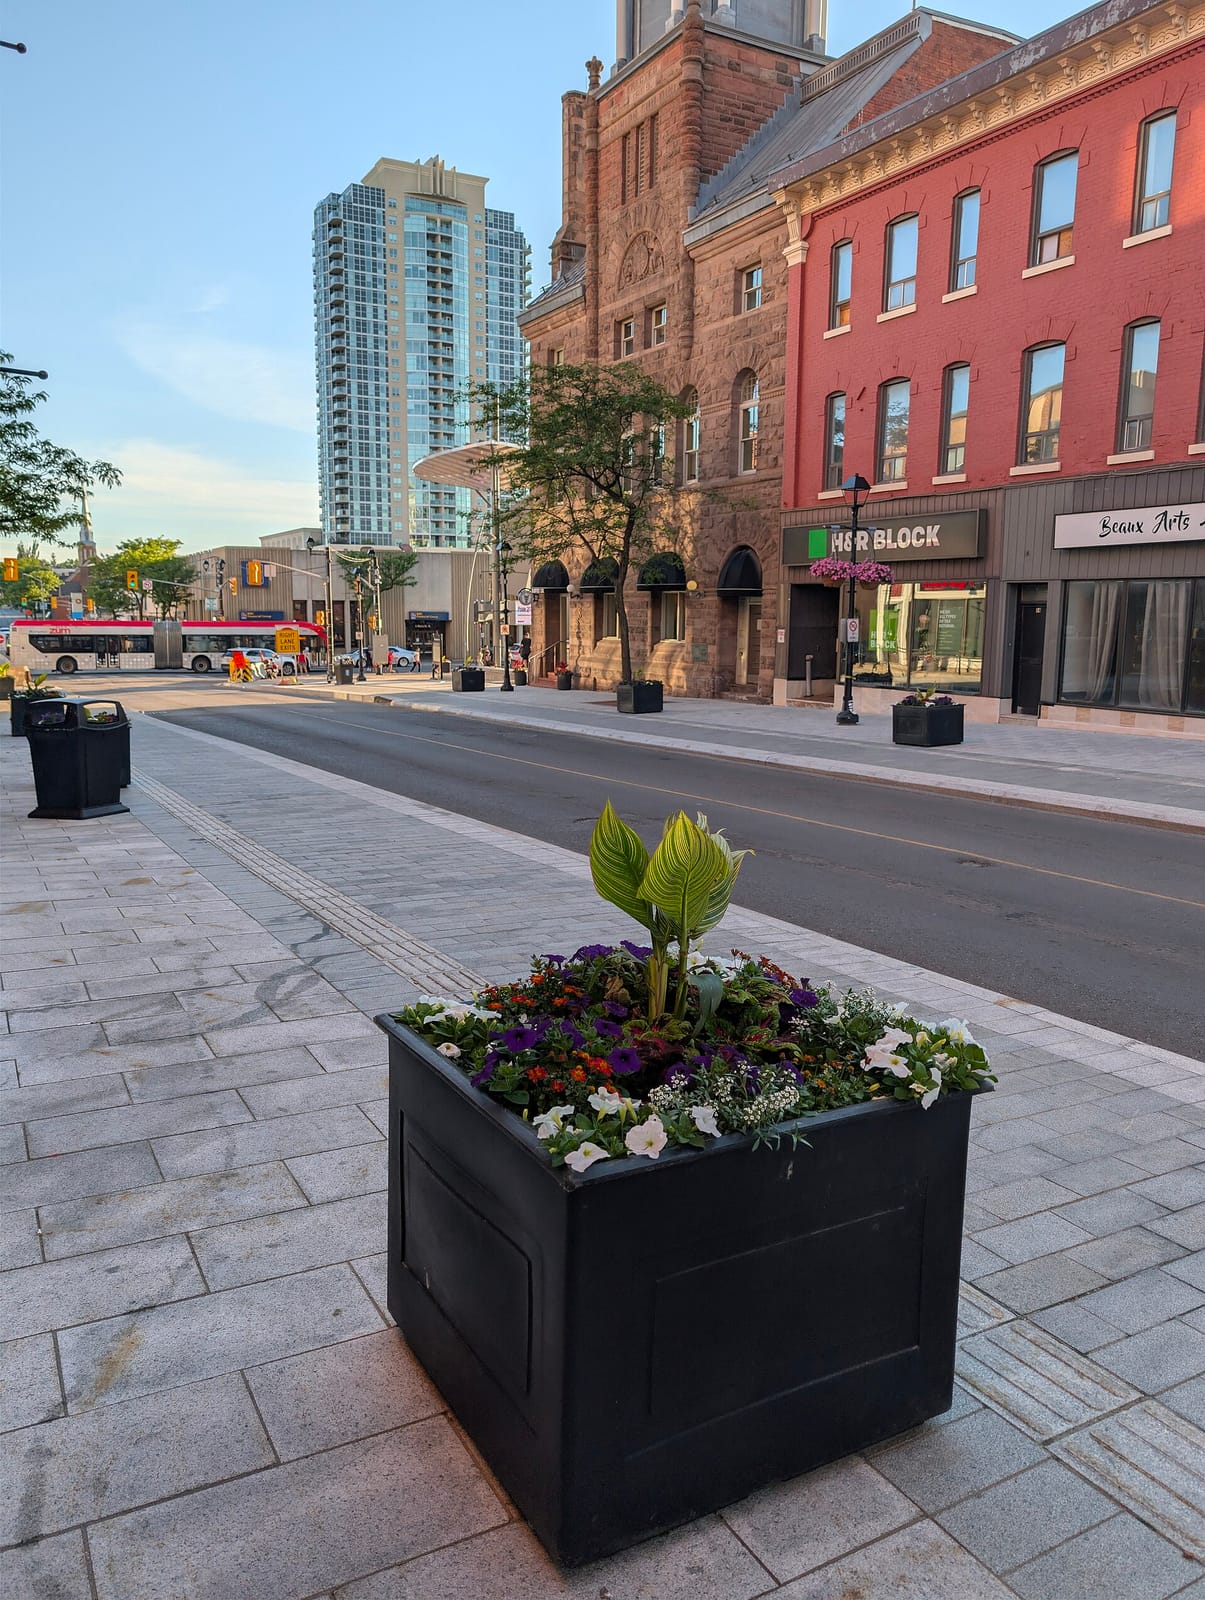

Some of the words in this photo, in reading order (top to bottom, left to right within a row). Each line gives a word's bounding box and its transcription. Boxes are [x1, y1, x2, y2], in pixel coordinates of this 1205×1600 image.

[1099, 515, 1144, 538] Beaux
[1152, 510, 1191, 534] Arts
[831, 531, 868, 552] H&R
[873, 525, 941, 550] BLOCK
